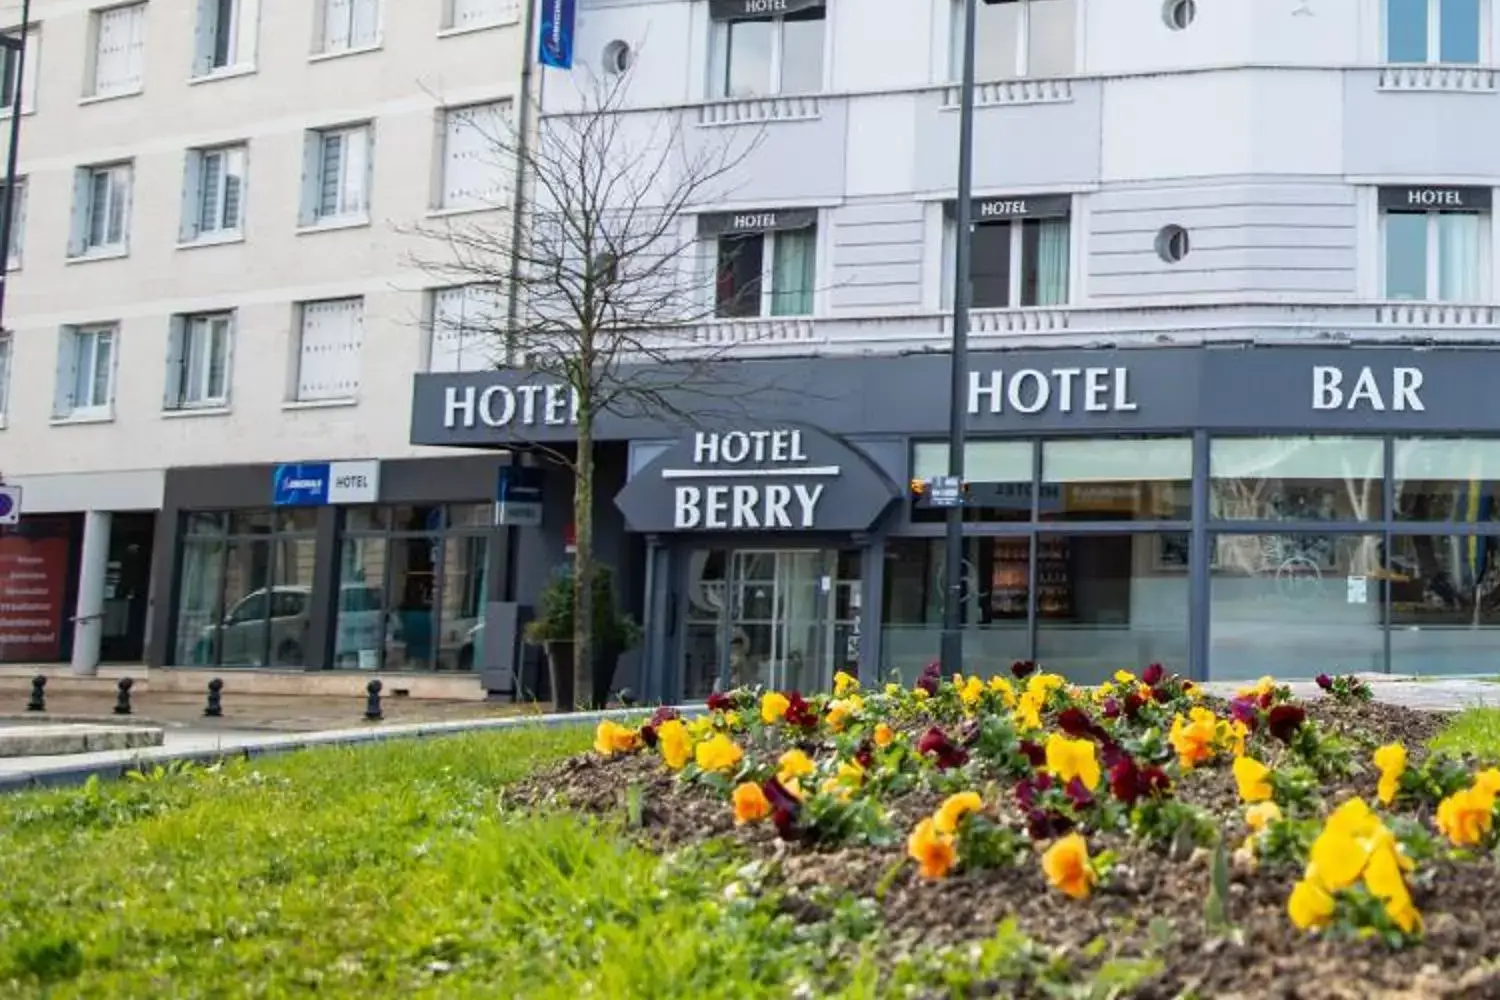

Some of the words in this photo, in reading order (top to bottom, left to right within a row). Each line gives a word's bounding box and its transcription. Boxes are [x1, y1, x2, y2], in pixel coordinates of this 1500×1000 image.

[981, 201, 1028, 215] HOTEL
[1408, 190, 1463, 205] HOTEL
[734, 213, 776, 228] HOTEL
[967, 367, 1137, 413] HOTEL
[1312, 366, 1425, 411] BAR
[694, 429, 807, 463] HOTEL
[336, 476, 368, 488] HOTEL
[675, 484, 823, 528] BERRY
